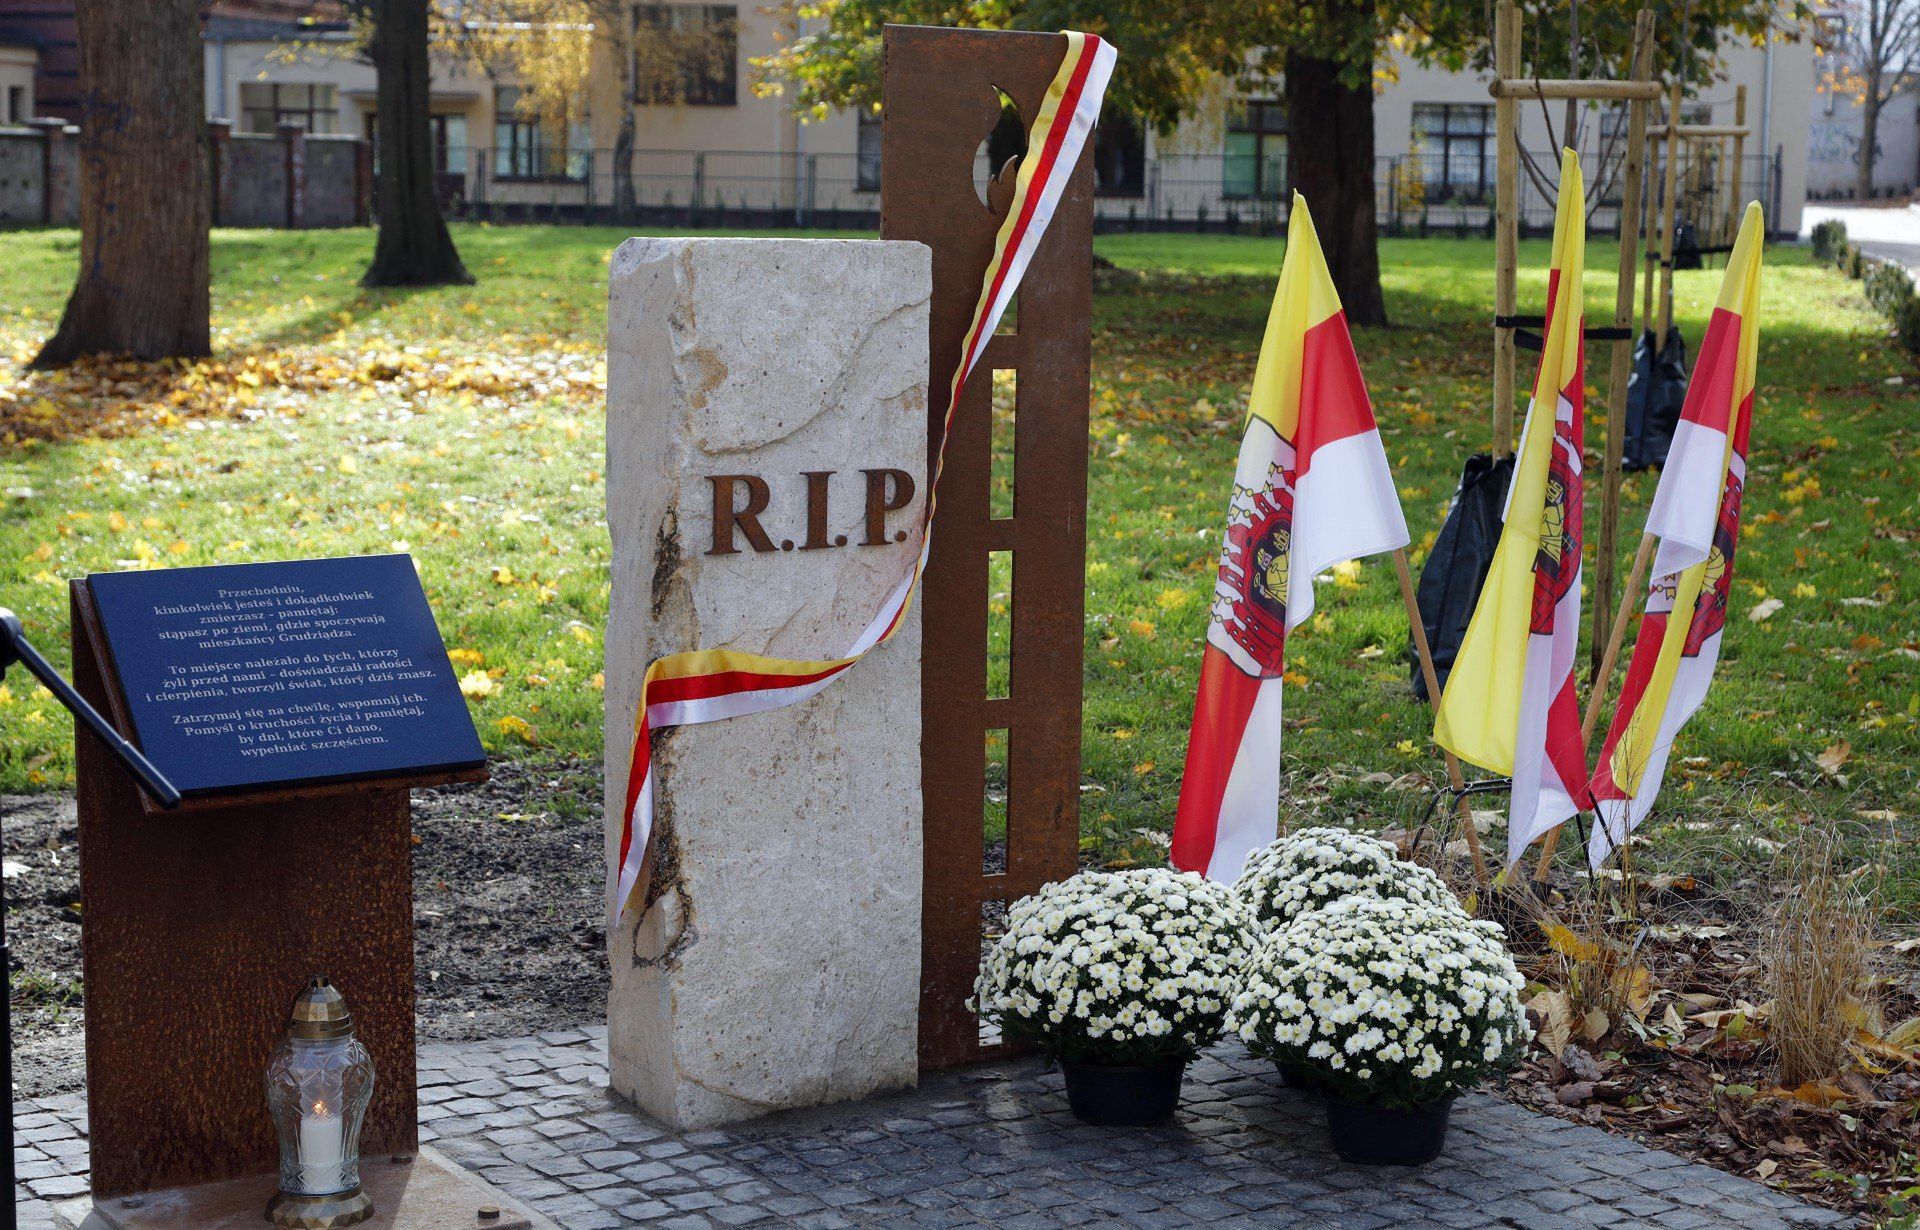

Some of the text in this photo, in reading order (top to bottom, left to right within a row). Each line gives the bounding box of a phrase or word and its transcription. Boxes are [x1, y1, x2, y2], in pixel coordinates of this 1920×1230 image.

[704, 468, 908, 555] R.I.P.
[154, 590, 374, 615] kimkolwiek jesteś i dokądkolwiek
[218, 584, 304, 598] Przechodniu,
[159, 614, 385, 641] stąpasz po ziemi, gdzie spoczywają
[200, 612, 264, 624] zmierzasz
[199, 635, 275, 649] mieszkańcy
[163, 677, 187, 689] żyli
[191, 674, 228, 688] przed
[232, 671, 266, 682] nami
[279, 662, 362, 677] doświadczali
[366, 658, 413, 671] radości
[168, 648, 399, 675] To miejsce należało do tych, którzy
[146, 693, 152, 702] i
[232, 681, 285, 695] tworzyli
[288, 678, 327, 690] świat,
[330, 675, 364, 686] który
[368, 671, 394, 682] dziś
[397, 670, 436, 680] znasz.
[172, 693, 427, 725] Zatrzymaj się na chwilę, wspomnij ich.
[185, 723, 234, 736] Pomyśl
[250, 715, 316, 730] kruchości
[319, 712, 353, 724] życia
[355, 711, 361, 720] i
[364, 706, 425, 721] pamiętaj,
[239, 723, 382, 745] by dni, które Ci dano,
[241, 735, 389, 757] wypełniać szczęściem.
